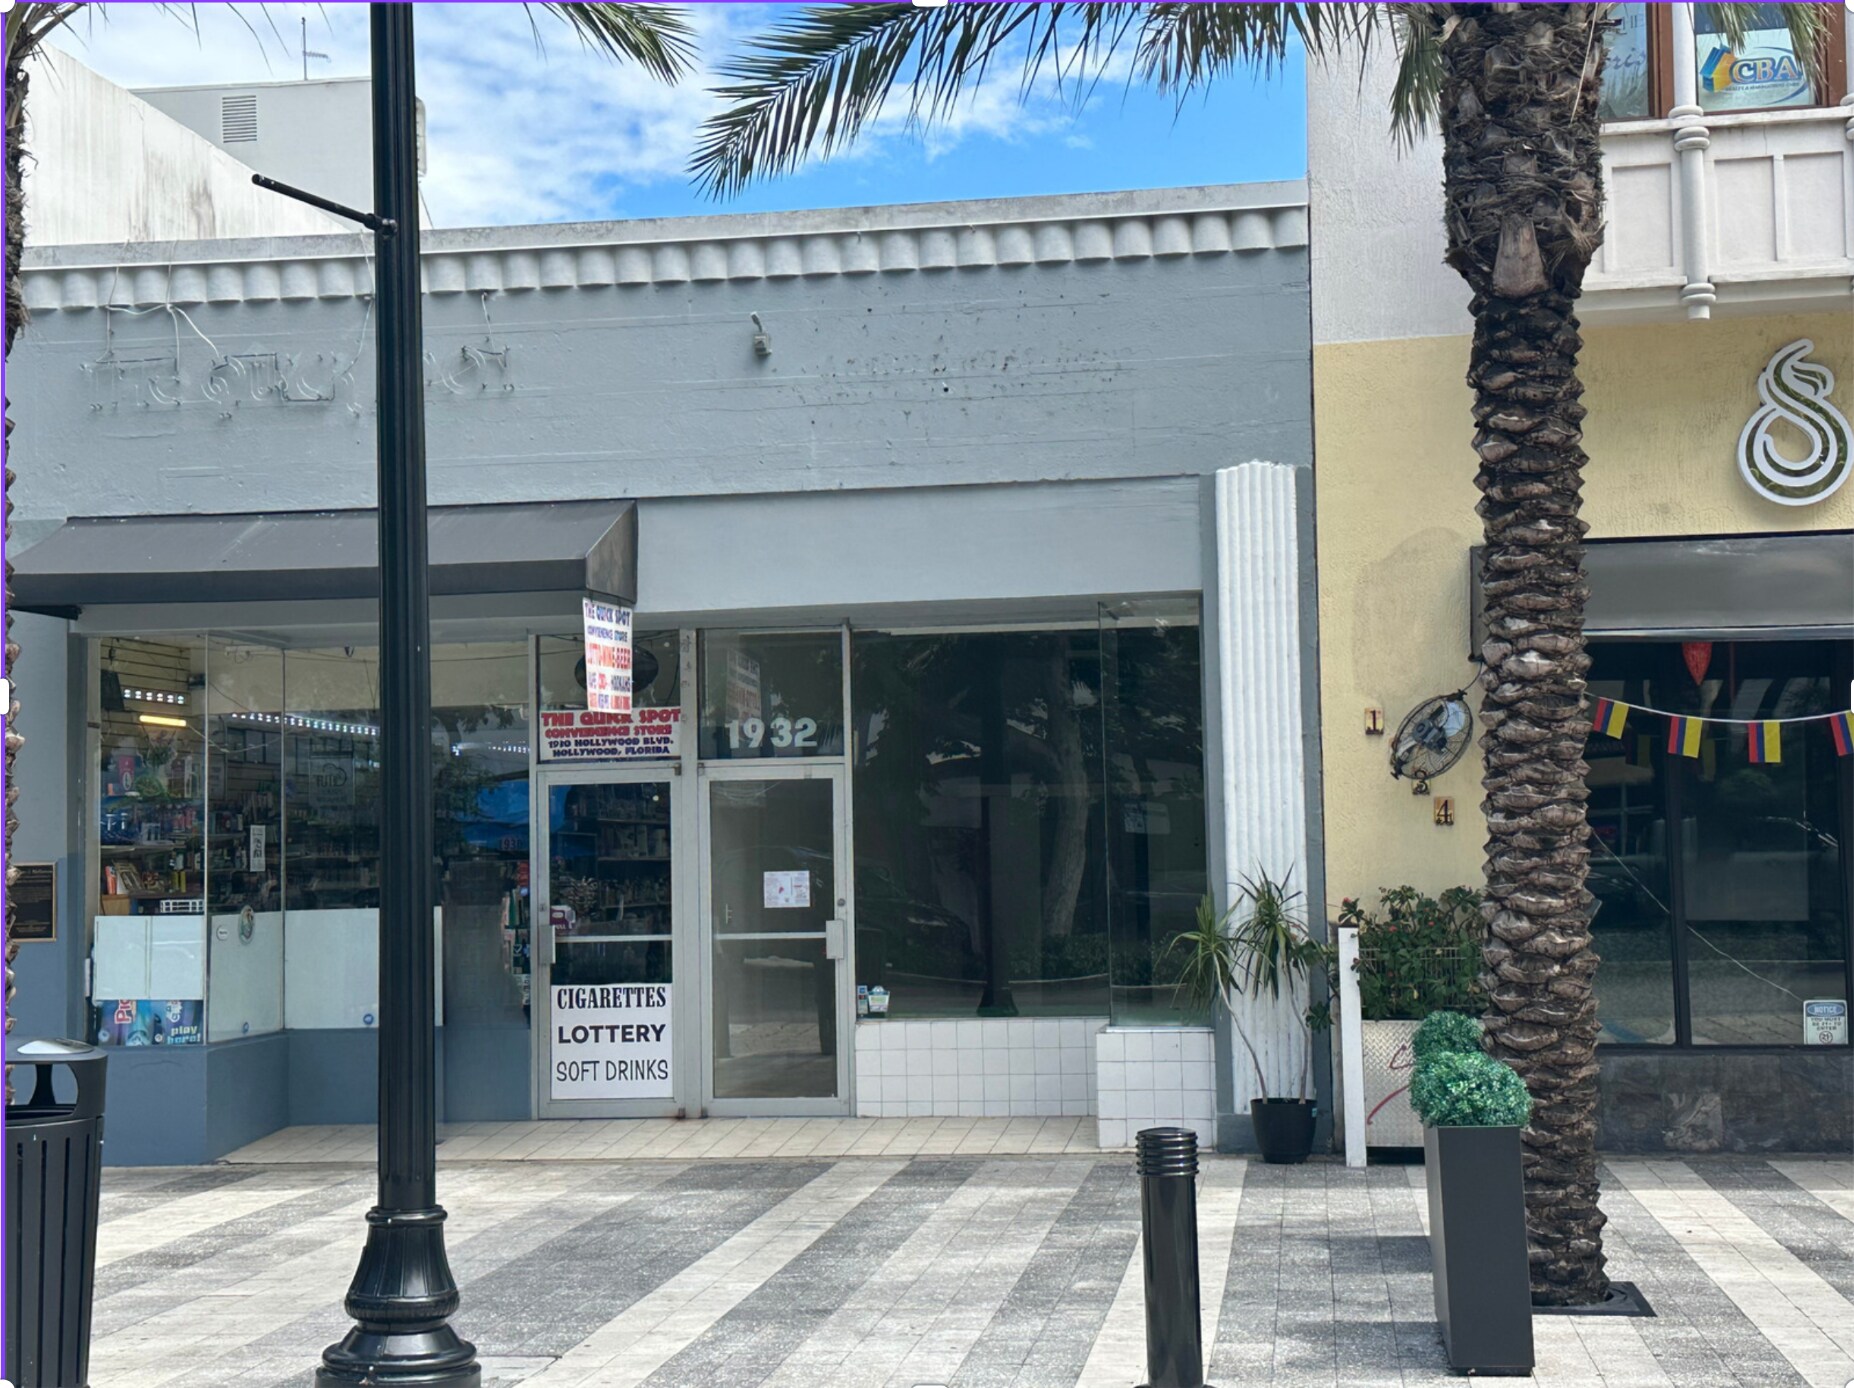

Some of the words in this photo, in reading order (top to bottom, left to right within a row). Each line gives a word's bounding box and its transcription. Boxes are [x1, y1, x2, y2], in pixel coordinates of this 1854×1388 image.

[1731, 57, 1799, 83] CBA
[541, 713, 574, 726] THE
[639, 709, 681, 723] SPOT
[545, 726, 630, 739] CONVENIENCE
[634, 725, 672, 736] STORE
[724, 717, 818, 749] 1932
[574, 738, 640, 747] HOLLYWOOD
[643, 736, 674, 745] BLVD.
[552, 748, 622, 757] HOLLYWOOD,
[625, 746, 670, 755] FLORIDA
[557, 986, 667, 1009] CIGARETTES
[166, 1034, 201, 1044] here!
[171, 1025, 198, 1036] play
[558, 1024, 666, 1044] LOTTERY
[556, 1060, 600, 1082] SOFT
[606, 1059, 668, 1081] DRINKS
